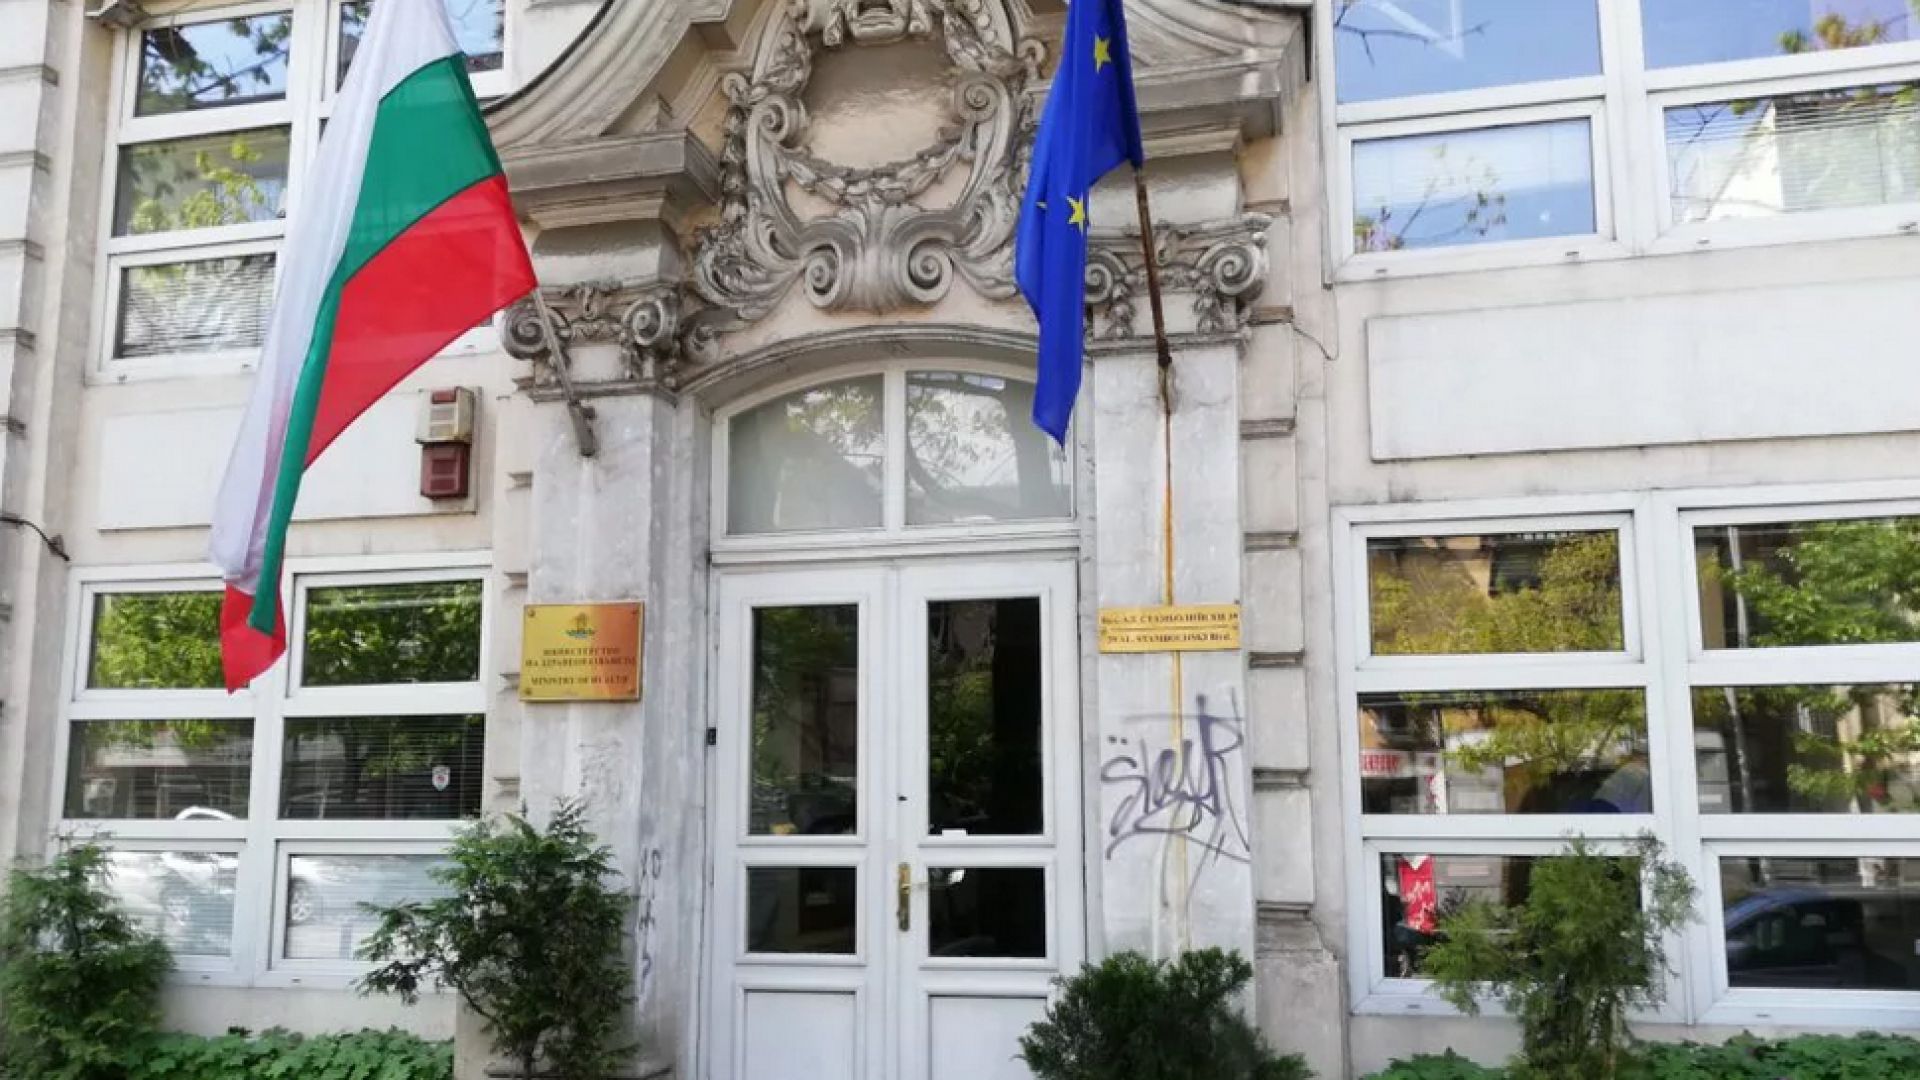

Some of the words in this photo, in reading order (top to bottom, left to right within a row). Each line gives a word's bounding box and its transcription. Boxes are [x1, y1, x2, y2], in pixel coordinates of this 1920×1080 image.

[525, 658, 538, 667] НА
[531, 676, 574, 686] MINISTRY
[577, 676, 588, 685] OF
[590, 675, 628, 685] HEALTH
